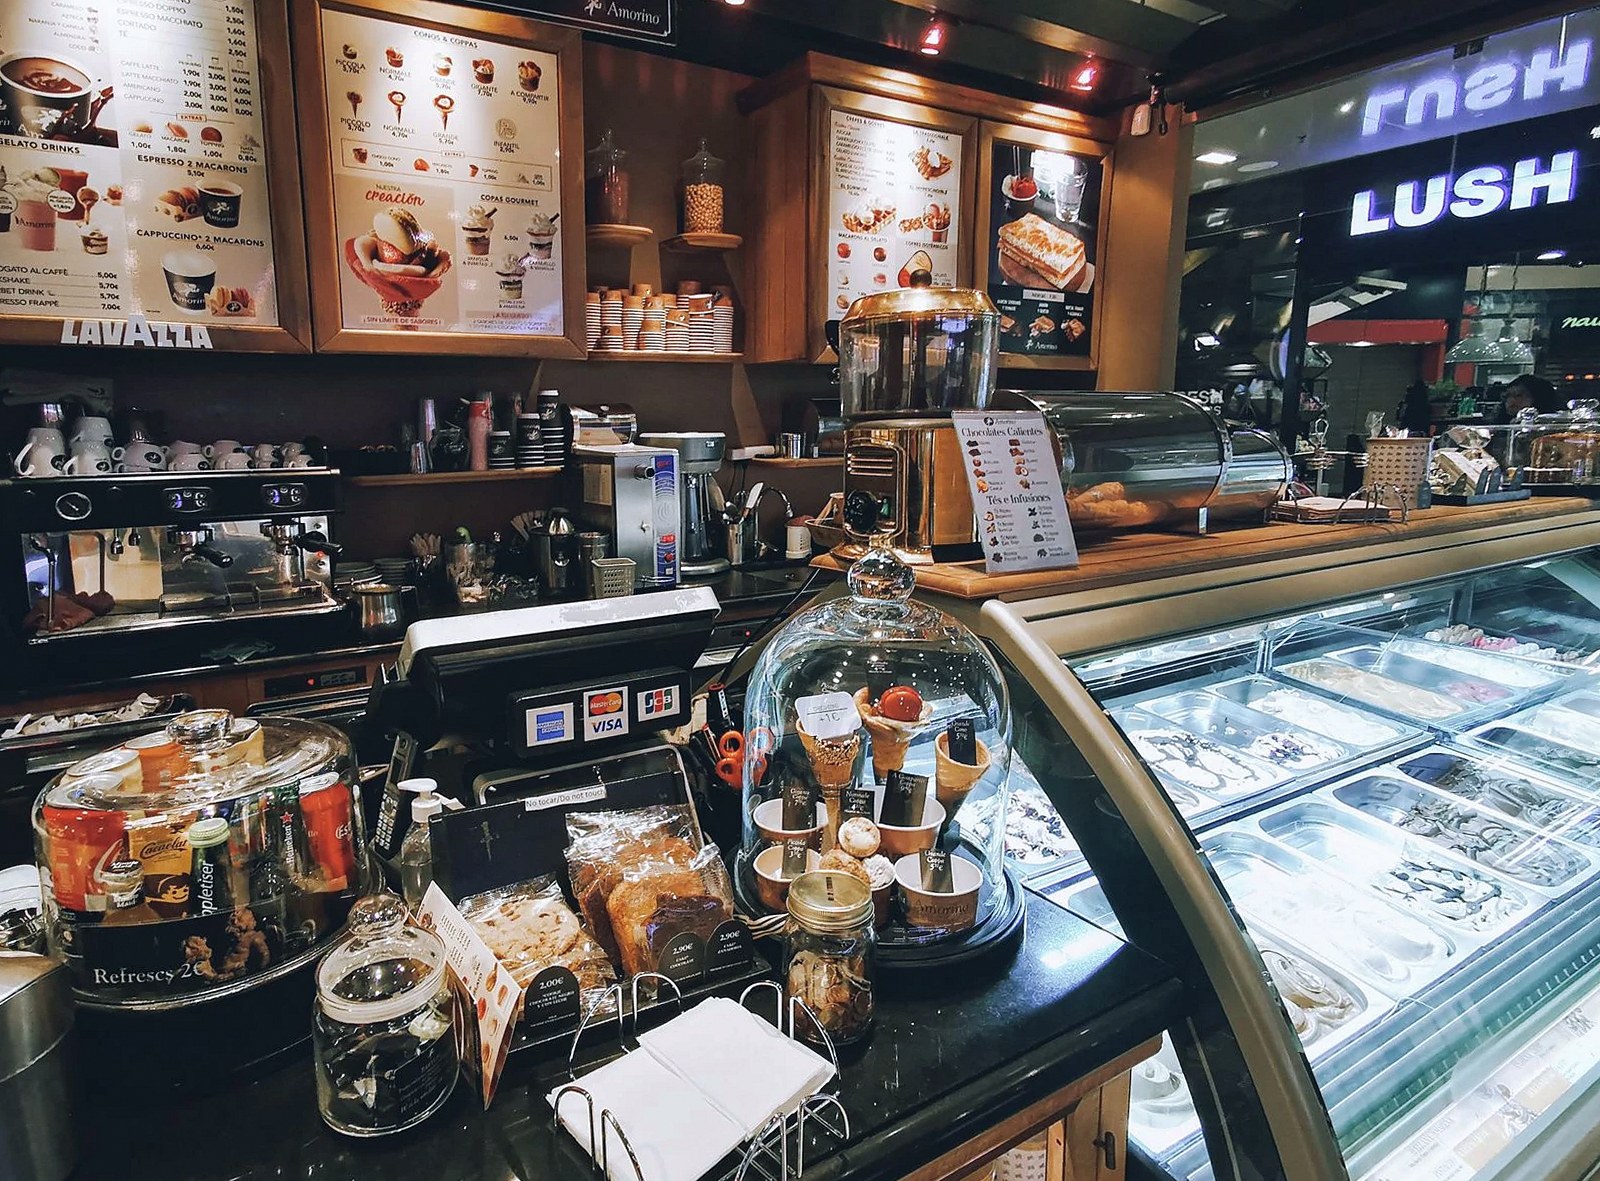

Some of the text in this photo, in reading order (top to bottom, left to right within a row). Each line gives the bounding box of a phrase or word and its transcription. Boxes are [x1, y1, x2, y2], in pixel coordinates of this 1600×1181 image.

[607, 1, 660, 25] Amorino
[414, 30, 441, 41] CONOS
[450, 38, 478, 49] COPPAS
[340, 117, 371, 129] PICCOLO
[41, 143, 80, 154] DRINKS
[138, 154, 248, 174] ESPRESSO 2 MACARONS
[365, 189, 425, 207] creación
[480, 193, 539, 207] COPAS GOURMET
[1350, 152, 1575, 236] LUSH
[213, 236, 265, 247] MACARONS
[30, 267, 41, 275] AL
[18, 288, 44, 296] DRINK
[60, 312, 213, 349] LAVAZZA
[961, 427, 1044, 437] Chocolates Calientes
[986, 495, 1002, 505] Tés
[1010, 493, 1051, 504] Infusiones
[590, 698, 622, 710] MasterCard
[646, 694, 672, 708] JCB
[591, 718, 623, 734] VISA
[571, 791, 583, 800] not
[140, 836, 188, 859] Cacaolat
[284, 824, 295, 865] Heineken
[93, 968, 174, 985] Refrescs
